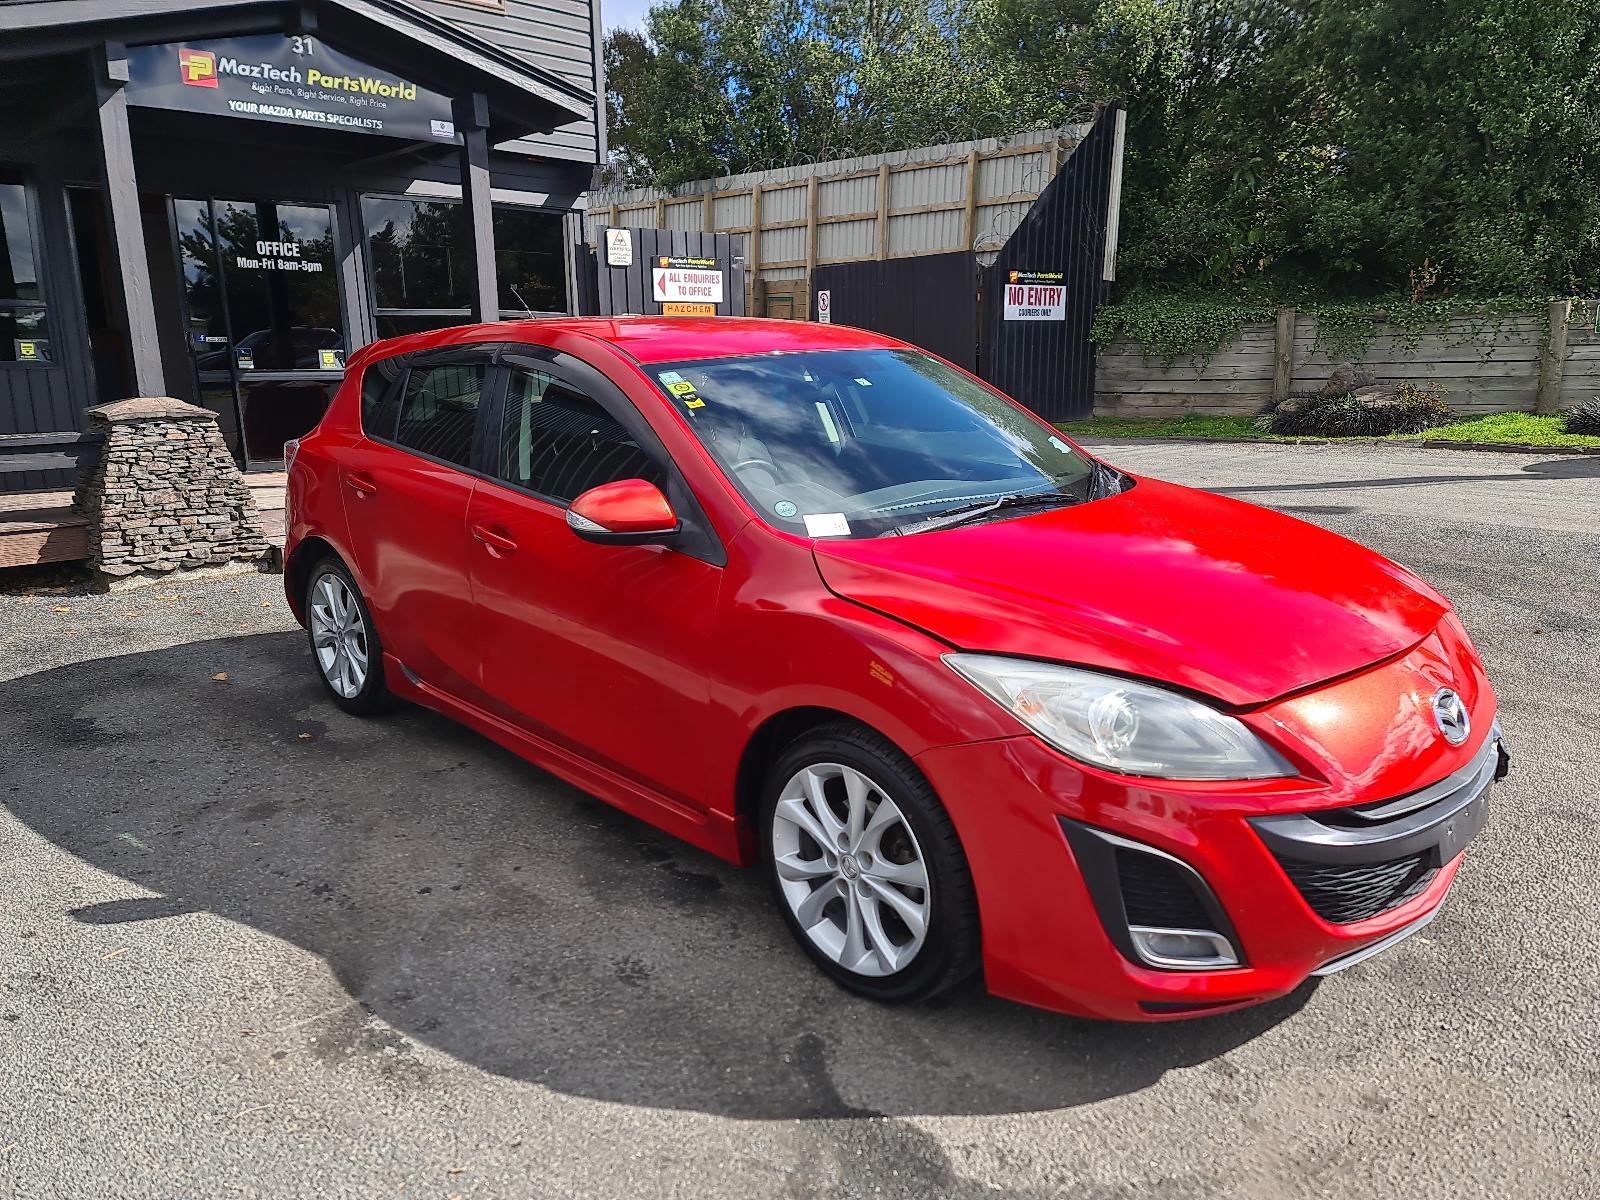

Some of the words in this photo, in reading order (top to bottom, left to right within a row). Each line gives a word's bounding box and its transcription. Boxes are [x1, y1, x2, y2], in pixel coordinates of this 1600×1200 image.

[291, 35, 313, 56] 31
[218, 57, 302, 83] MazTech
[307, 68, 417, 101] PartsWorld
[251, 82, 273, 94] Right
[274, 85, 295, 97] Parts,
[297, 88, 317, 100] Right
[318, 91, 347, 103] Service,
[349, 95, 367, 107] Right
[369, 98, 387, 109] Price
[228, 100, 258, 113] YOUR
[259, 104, 294, 119] MAZDA
[295, 109, 326, 122] PARTS
[326, 112, 383, 129] SPECIALISTS
[256, 240, 301, 257] OFFICE
[236, 256, 276, 270] Mon-Fri
[277, 258, 323, 273] 8am-5pm
[669, 272, 682, 283] ALL
[683, 273, 720, 284] ENQUIRIES
[678, 285, 687, 296] TO
[689, 286, 712, 297] OFFICE
[1009, 287, 1024, 305] NO
[1028, 287, 1062, 306] ENTRY
[667, 305, 711, 313] HAZCHEM
